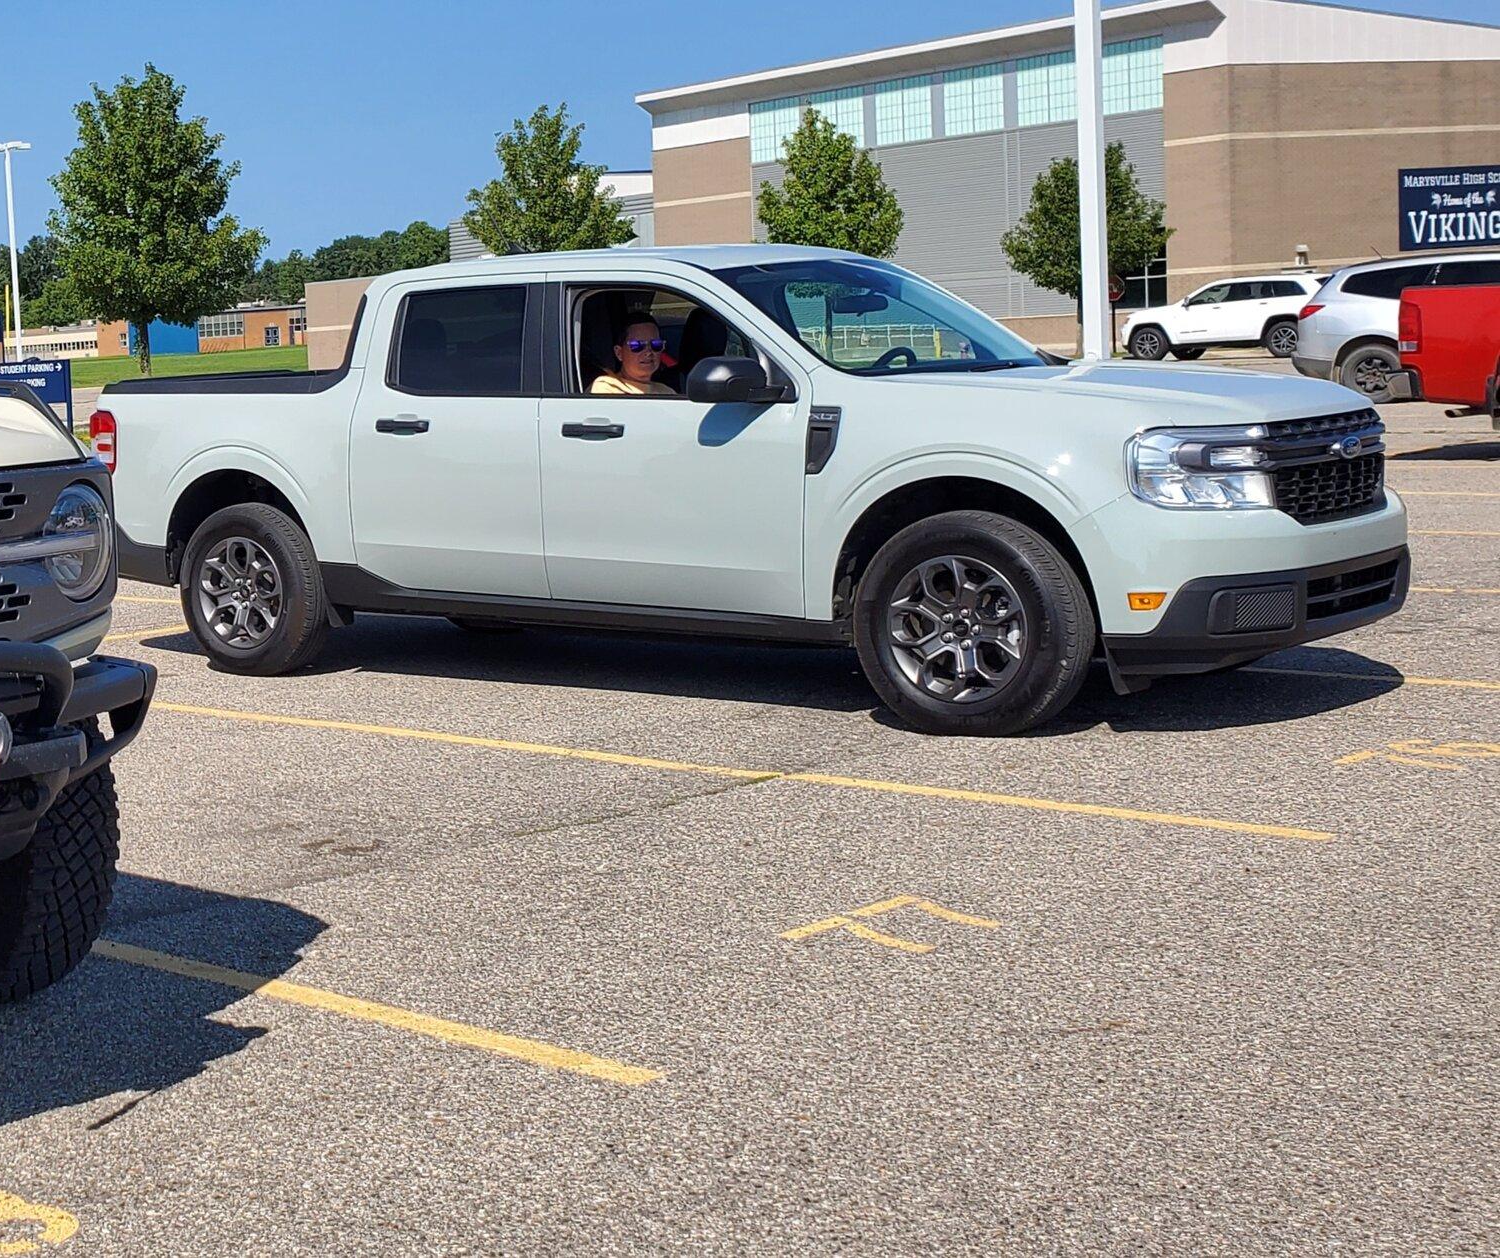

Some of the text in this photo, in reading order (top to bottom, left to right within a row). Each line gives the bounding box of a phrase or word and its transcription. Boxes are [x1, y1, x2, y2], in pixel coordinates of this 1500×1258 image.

[1404, 175, 1460, 187] MARYSVILLE
[1462, 173, 1485, 184] HIGH
[0, 363, 54, 374] STUDENT PARKING
